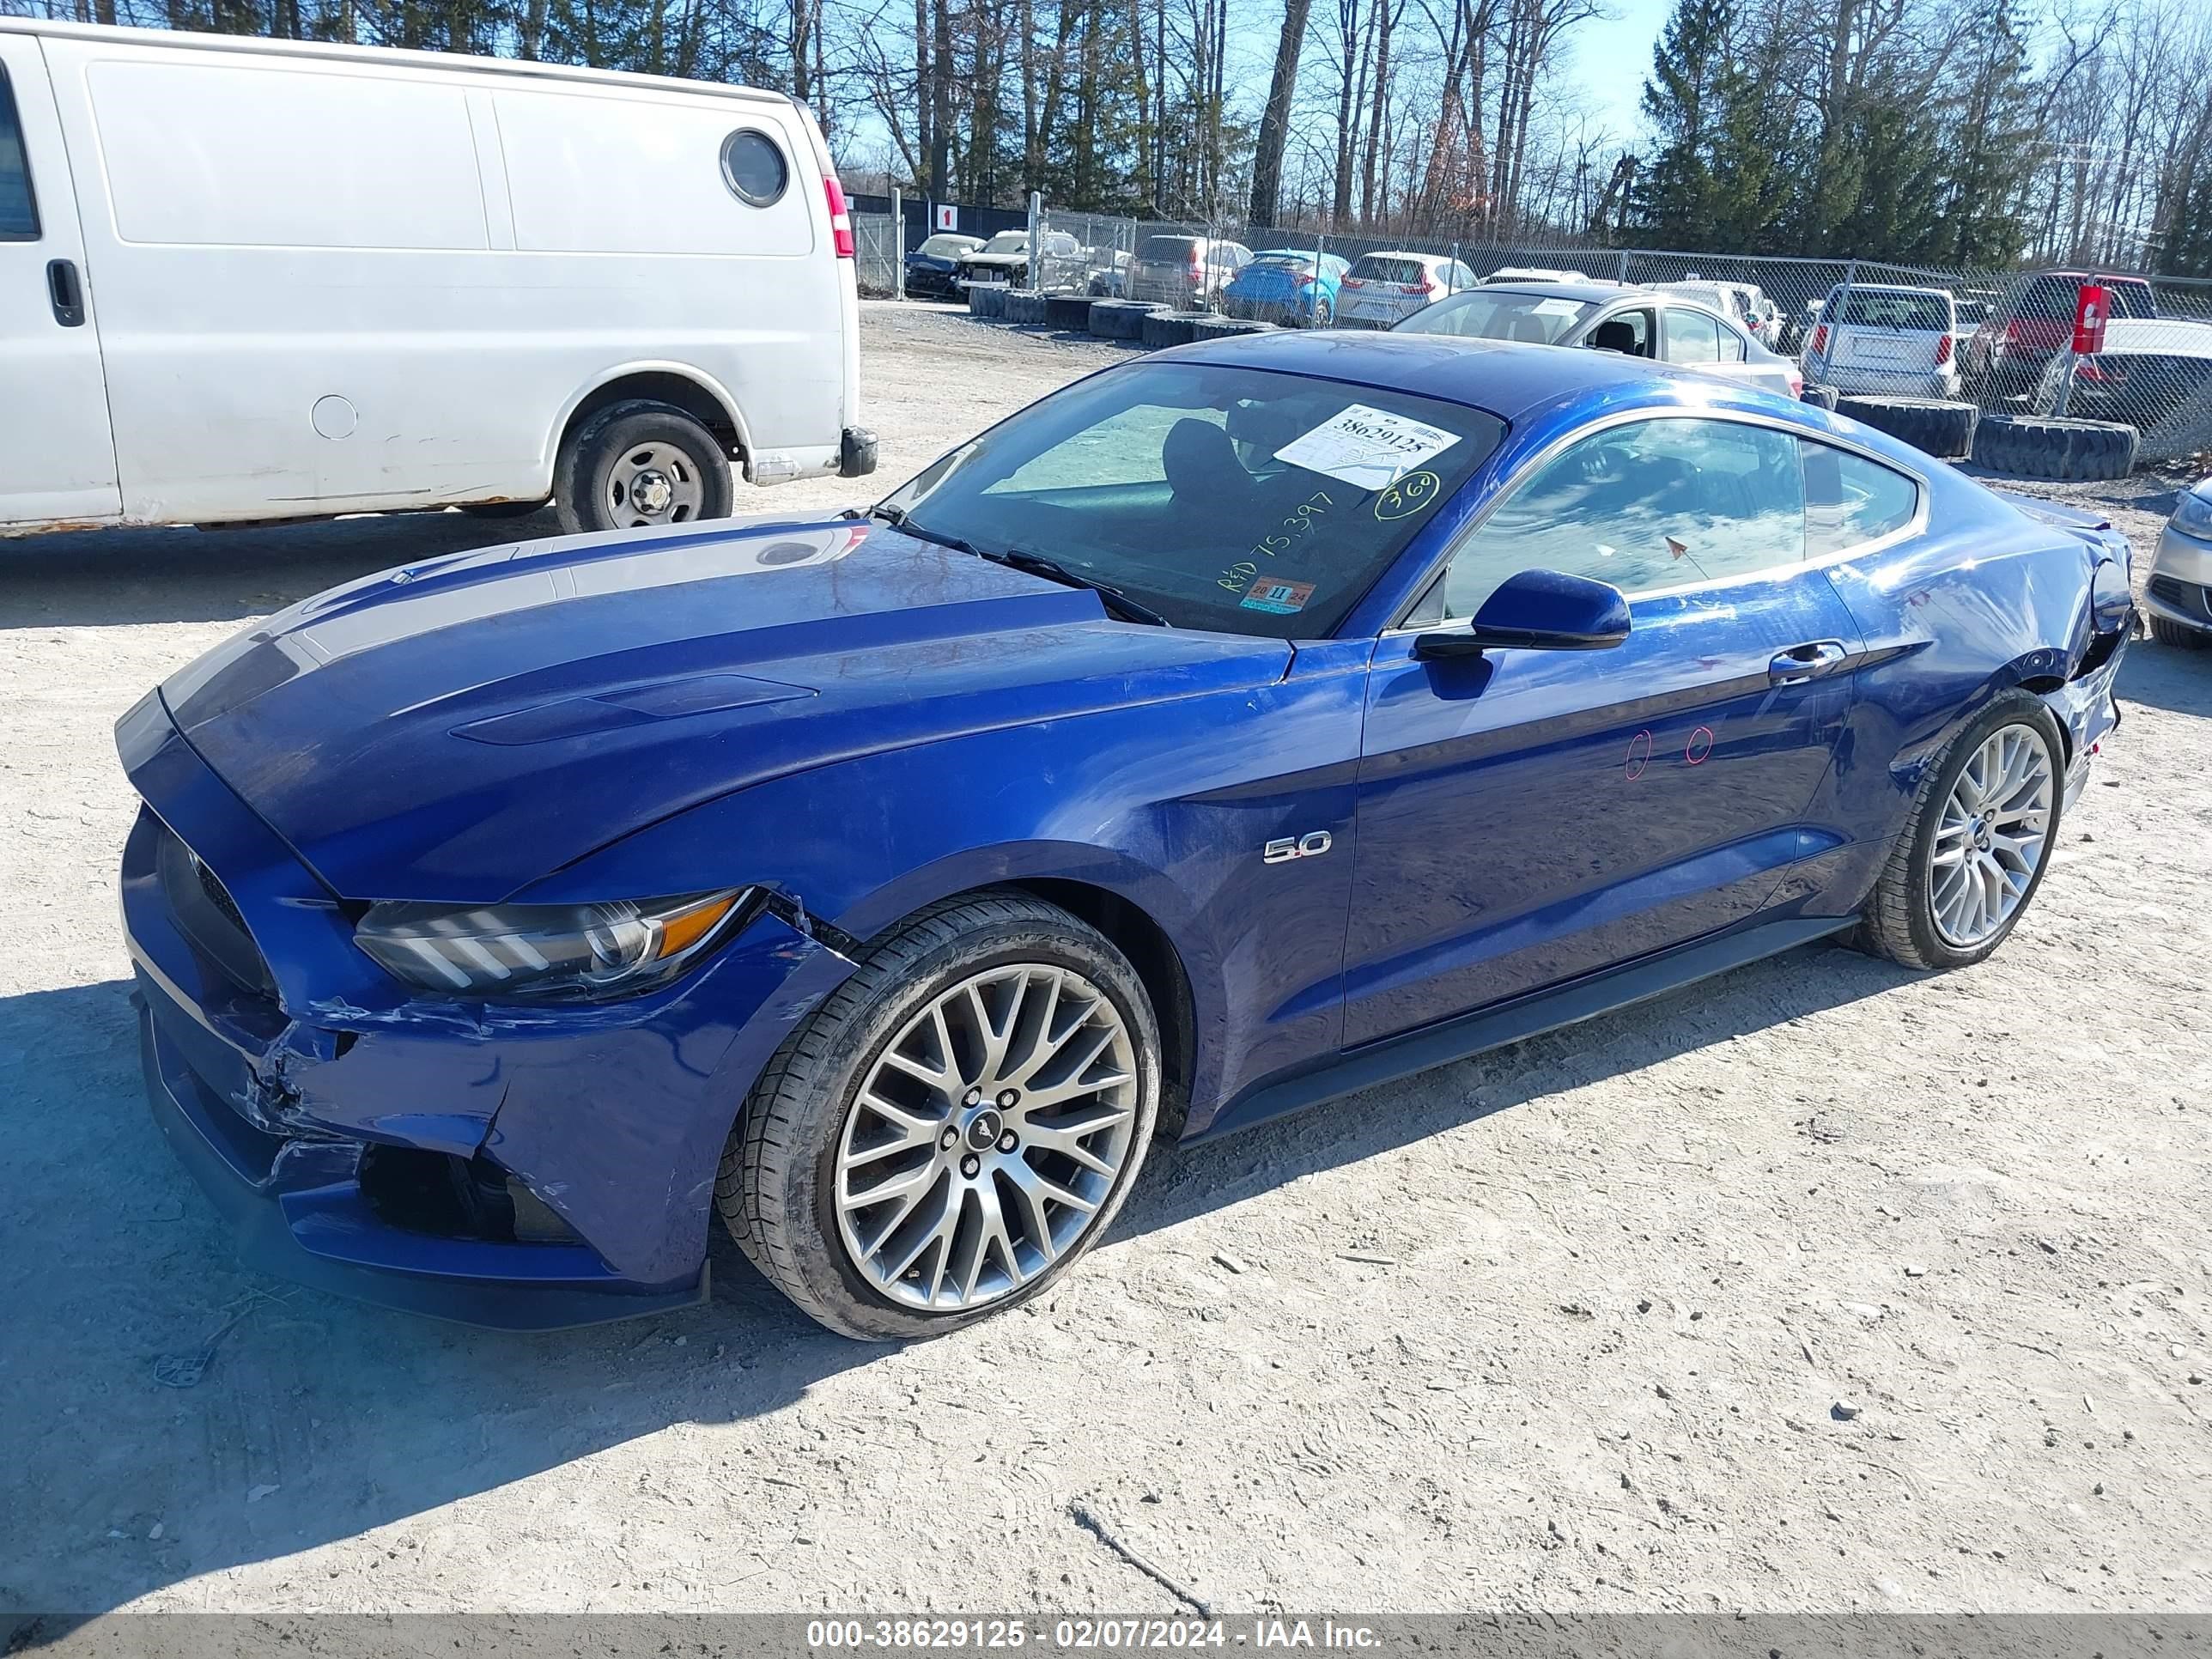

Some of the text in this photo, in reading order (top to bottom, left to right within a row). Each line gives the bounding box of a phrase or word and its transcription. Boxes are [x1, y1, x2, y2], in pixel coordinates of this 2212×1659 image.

[944, 210, 951, 227] 1
[1334, 419, 1425, 453] 38629125
[1253, 586, 1306, 601] 20 11 24
[1263, 830, 1332, 865] 5.0
